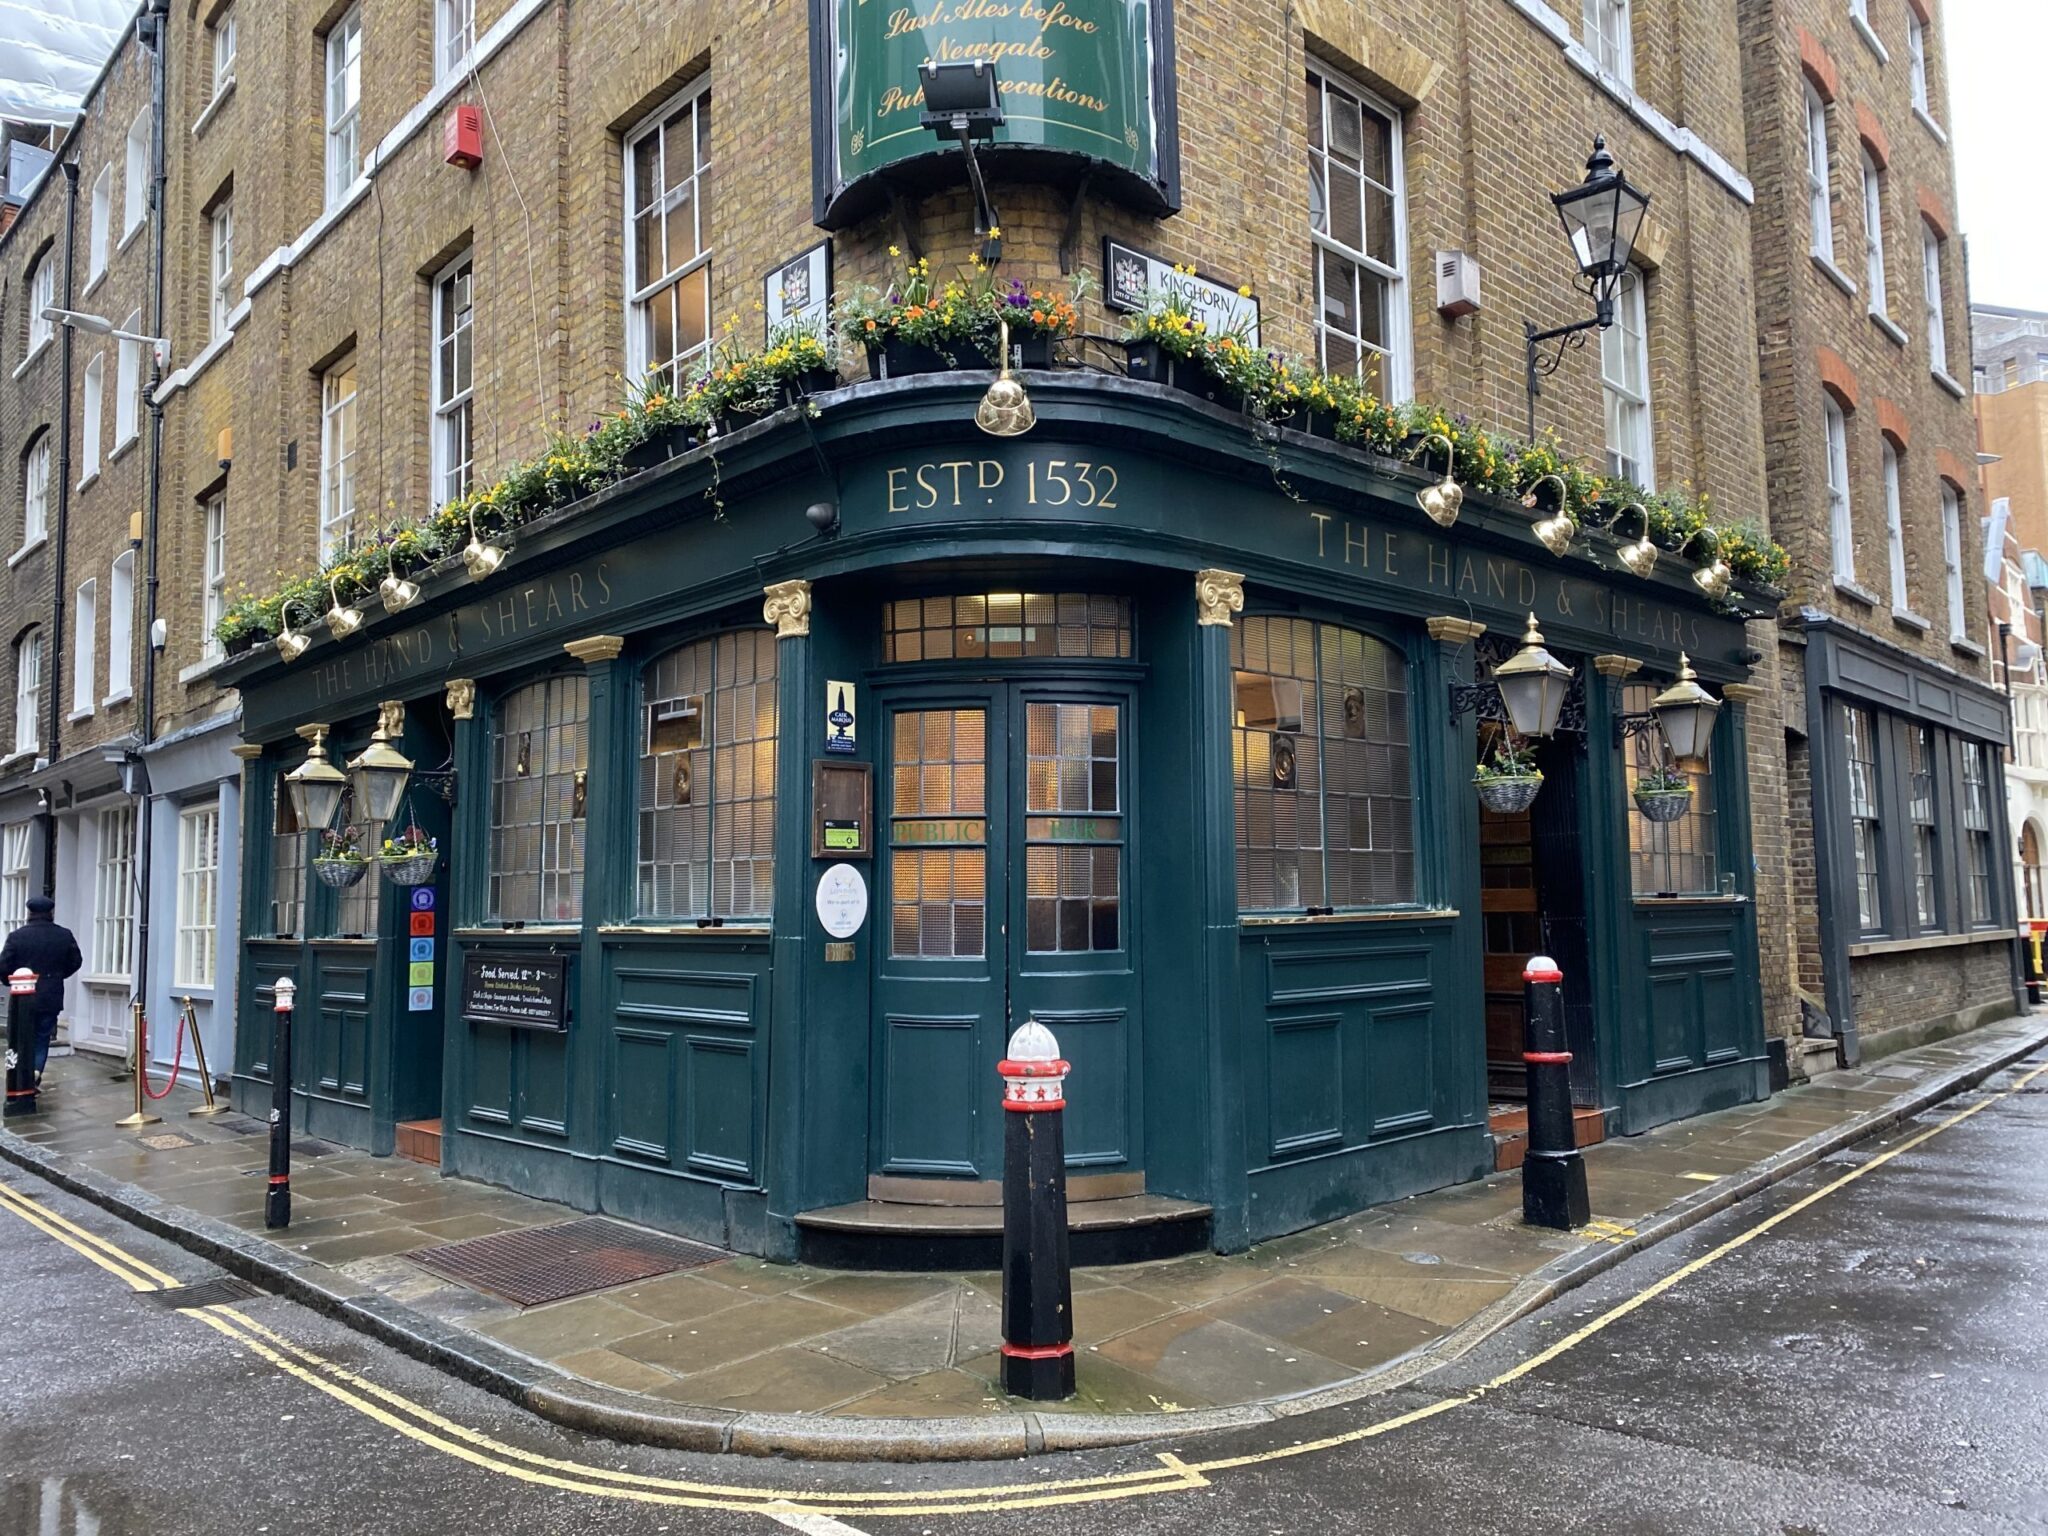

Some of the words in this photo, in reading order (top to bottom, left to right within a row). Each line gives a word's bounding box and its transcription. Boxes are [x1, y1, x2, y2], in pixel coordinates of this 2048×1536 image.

[884, 1, 944, 39] Last
[944, 0, 1016, 23] Ales
[1020, 0, 1099, 33] before
[924, 35, 1056, 64] Newgate
[1160, 271, 1230, 313] KINGHORN
[1027, 460, 1117, 509] 1532
[1310, 512, 1398, 576] THE
[1428, 544, 1536, 607] HAND
[1557, 579, 1574, 617] &
[1594, 589, 1699, 650] SHEARS
[312, 659, 352, 699] THE
[364, 628, 432, 683] HAND
[449, 614, 464, 652] &
[480, 563, 610, 643] SHEARS
[894, 822, 979, 842] PUBLIC
[1049, 820, 1098, 839] BAR
[481, 964, 496, 978] Food
[498, 967, 519, 980] Served
